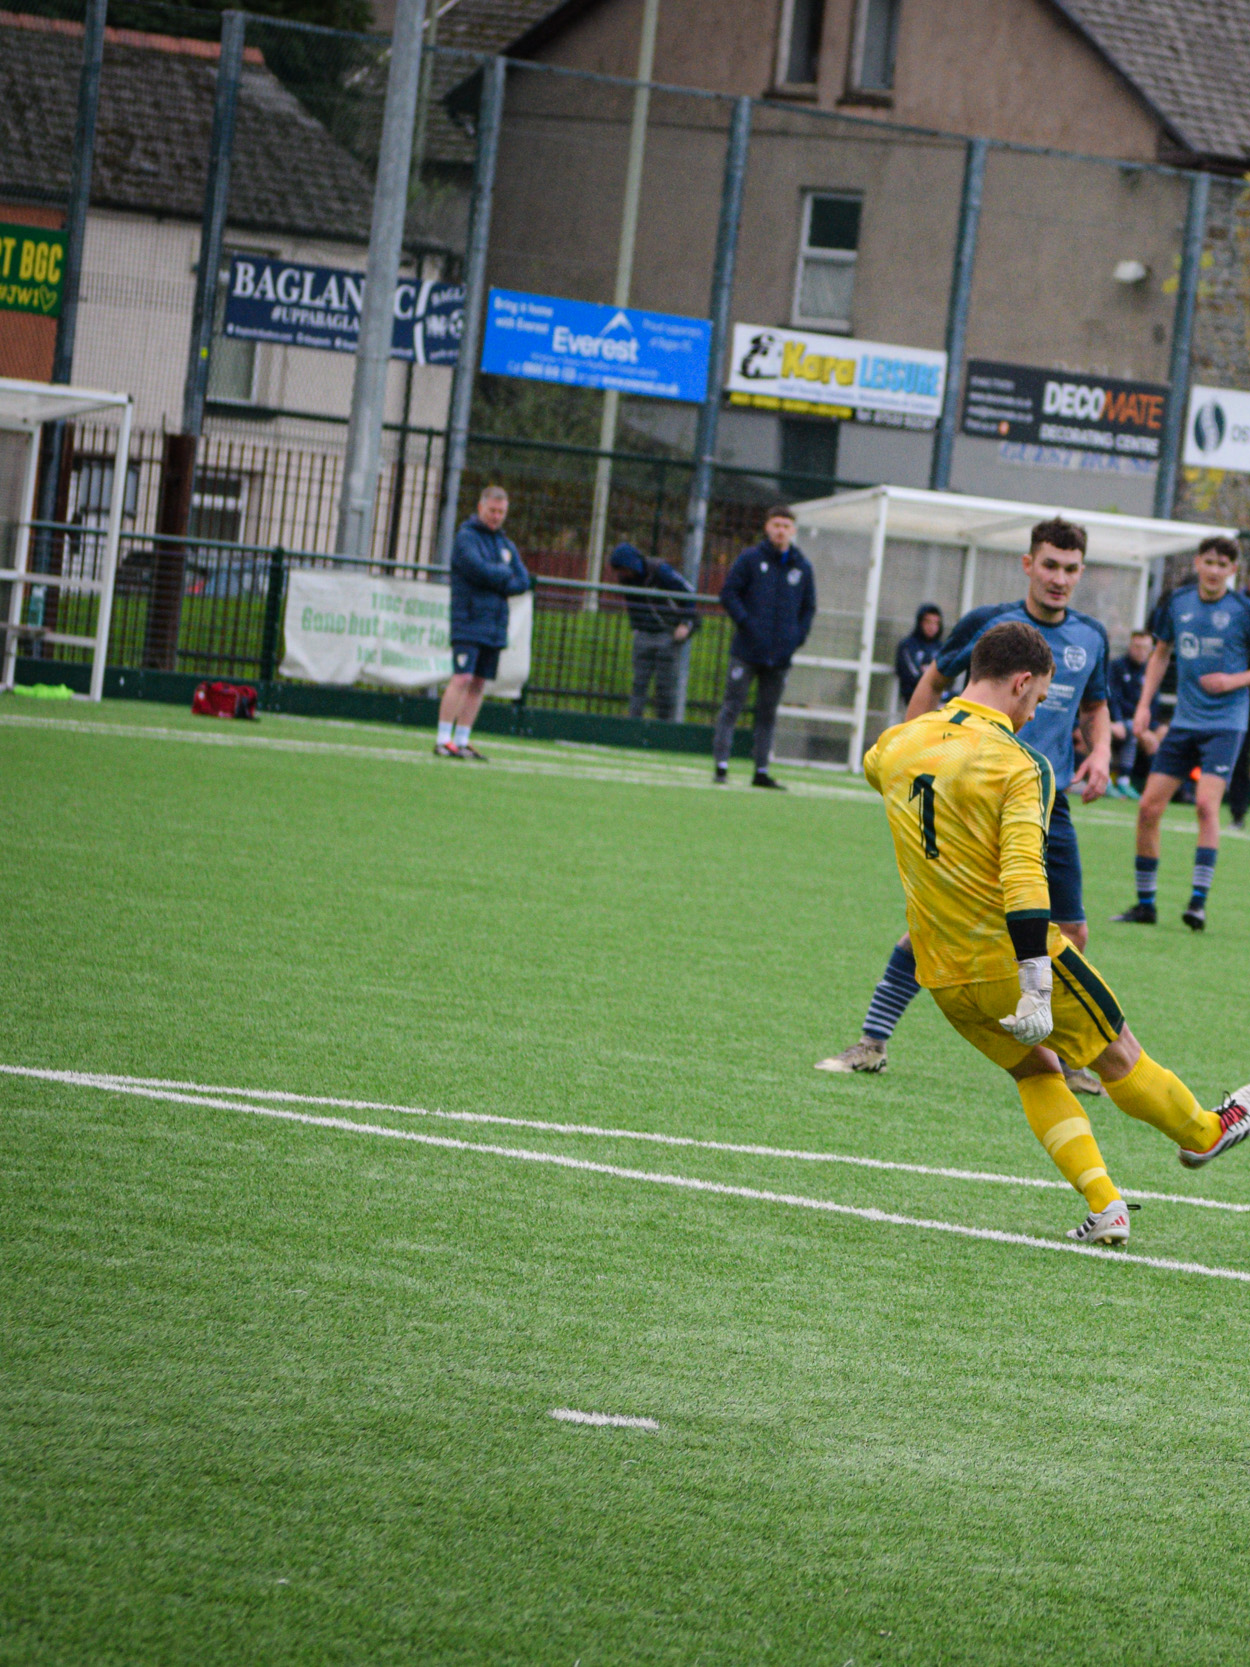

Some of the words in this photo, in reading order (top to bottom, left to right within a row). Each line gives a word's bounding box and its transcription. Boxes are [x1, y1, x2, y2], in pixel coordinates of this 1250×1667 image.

[0, 236, 16, 278] T
[19, 240, 63, 285] BGC
[271, 304, 360, 335] #UPPABAGLA
[553, 325, 639, 363] Everest
[781, 340, 856, 386] Kara
[859, 354, 941, 397] LEISURE
[1043, 381, 1164, 429] DECOMATE
[1038, 423, 1114, 448] DECORATING
[302, 605, 346, 635] Gone
[348, 610, 379, 637] but
[909, 773, 939, 860] 1
